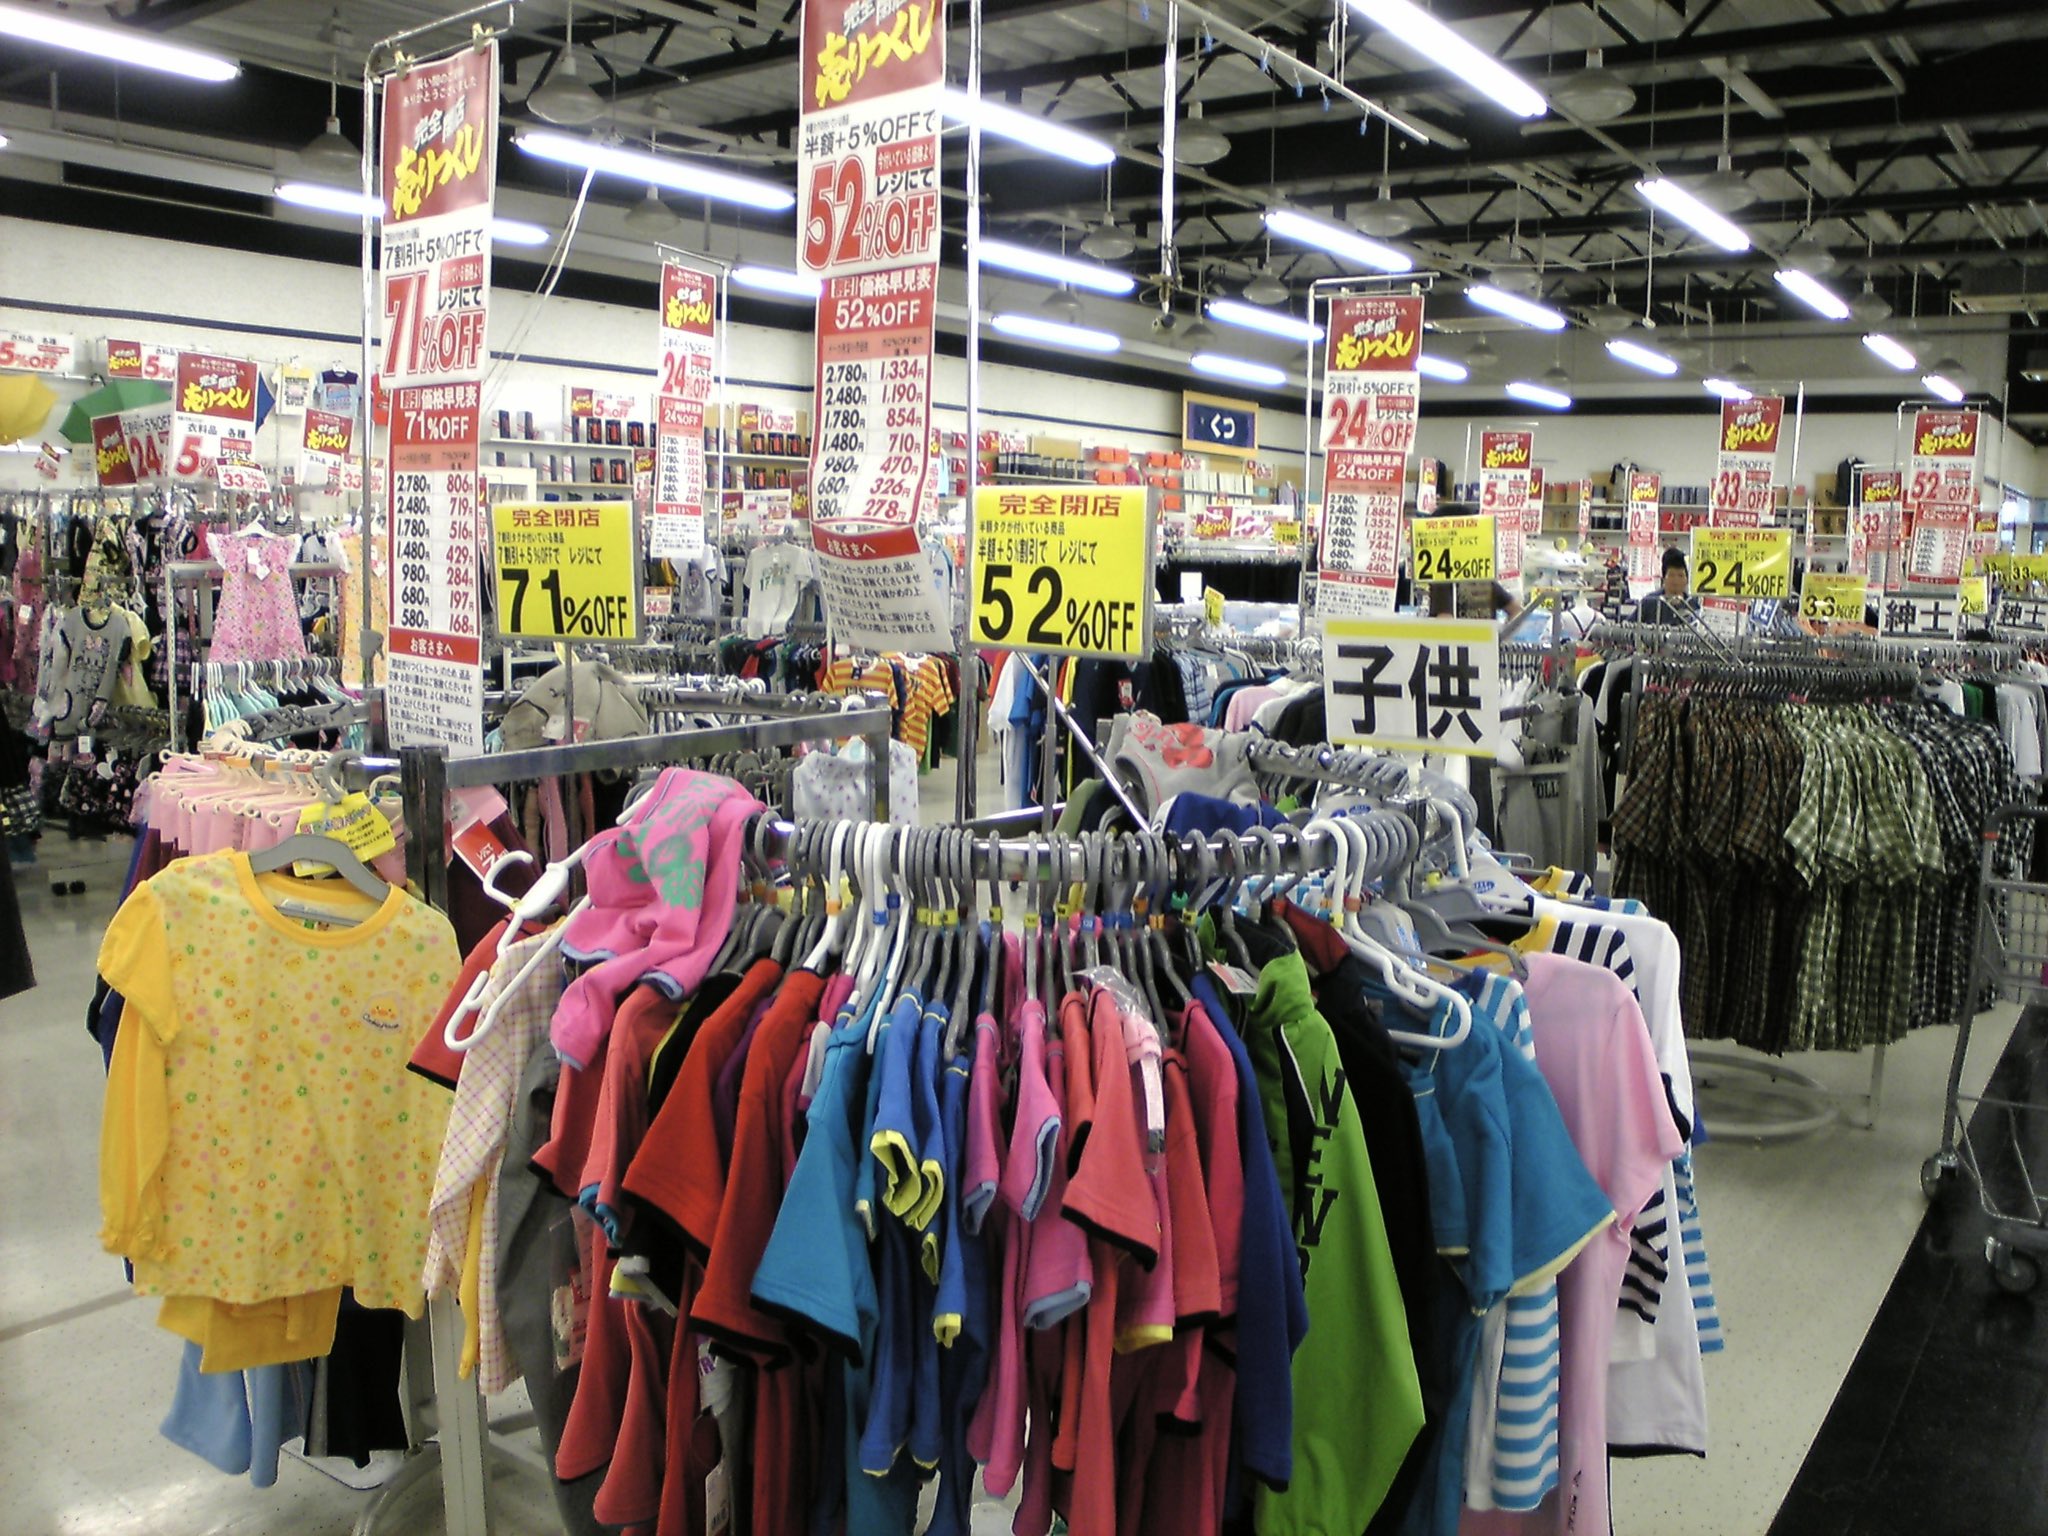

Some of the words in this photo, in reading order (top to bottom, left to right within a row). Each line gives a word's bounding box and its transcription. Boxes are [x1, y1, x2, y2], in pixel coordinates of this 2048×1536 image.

[815, 0, 936, 108] 売りつくし
[393, 117, 484, 219] 売りつくし
[876, 167, 934, 197] レジにて
[803, 155, 938, 271] 52%OFF
[438, 285, 482, 311] レジにて
[382, 270, 487, 378] 71%OFF
[835, 298, 921, 330] 52%OFF
[1335, 330, 1415, 370] 売りつくし
[662, 351, 711, 398] 24%OFF
[183, 381, 251, 412] 売りつくし
[405, 411, 469, 440] 71%OFF
[664, 409, 699, 425] 24%OFF
[1328, 398, 1413, 447] 24%OFF
[1336, 466, 1395, 481] 24%OFF
[512, 509, 600, 527] 完全閉店
[999, 494, 1122, 517] 完全閉店
[569, 547, 602, 565] レジにて
[826, 537, 876, 558] お客さまへ
[1059, 540, 1098, 565] レジにて
[1418, 548, 1490, 579] 24%OFF
[1697, 560, 1784, 595] 24%OFF
[501, 568, 627, 637] 71%OFF
[979, 564, 1135, 652] 52%OFF
[1885, 600, 1953, 633] 紳士
[411, 637, 454, 656] お客さまへ
[1332, 644, 1483, 744] 子供
